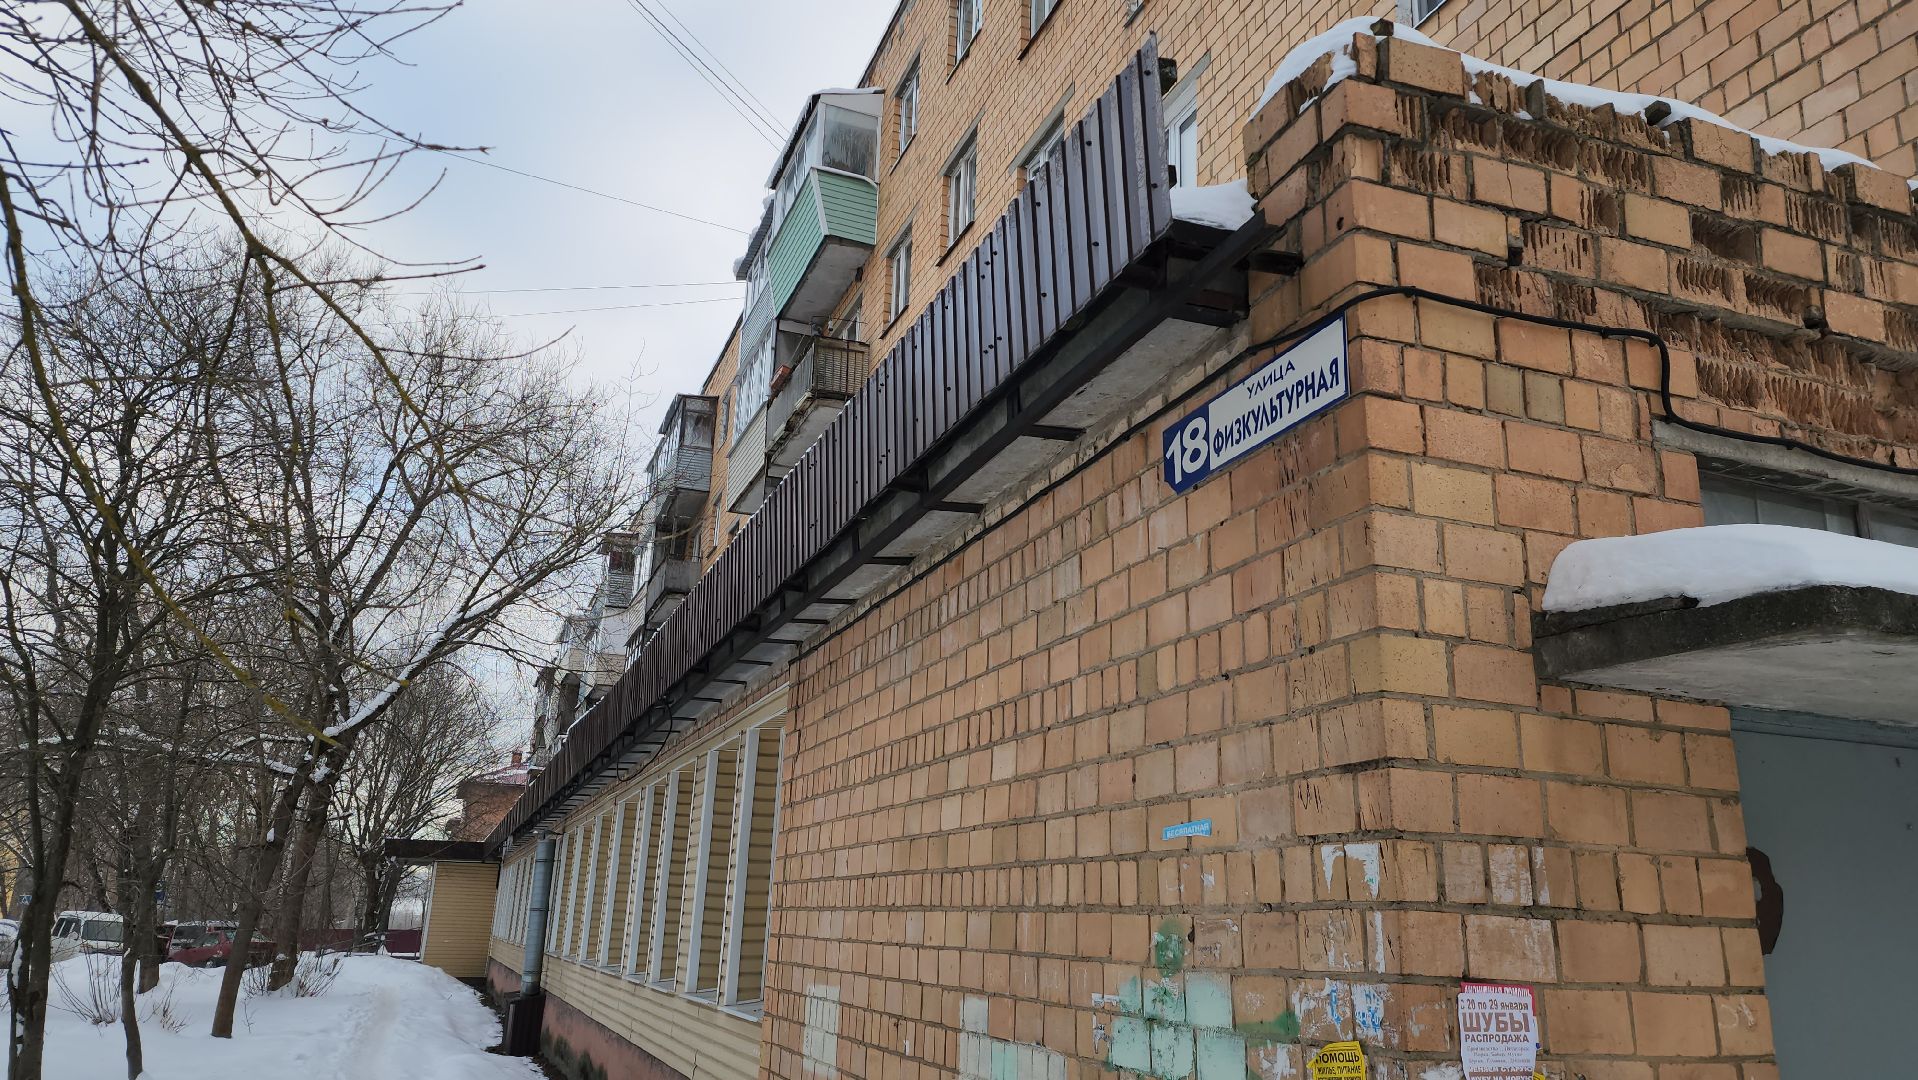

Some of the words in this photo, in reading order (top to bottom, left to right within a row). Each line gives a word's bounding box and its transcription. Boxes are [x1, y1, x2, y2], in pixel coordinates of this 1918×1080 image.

[1247, 360, 1295, 399] УЛИЦА
[1213, 357, 1339, 457] ФИЗКУЛЬТУРНАЯ
[1165, 417, 1208, 484] 18
[1478, 1002, 1487, 1010] по
[1489, 999, 1498, 1010] 29
[1501, 1002, 1528, 1012] января
[1462, 1012, 1530, 1032] ШУБЫ
[1465, 1034, 1529, 1044] РАСПРОДАЖА
